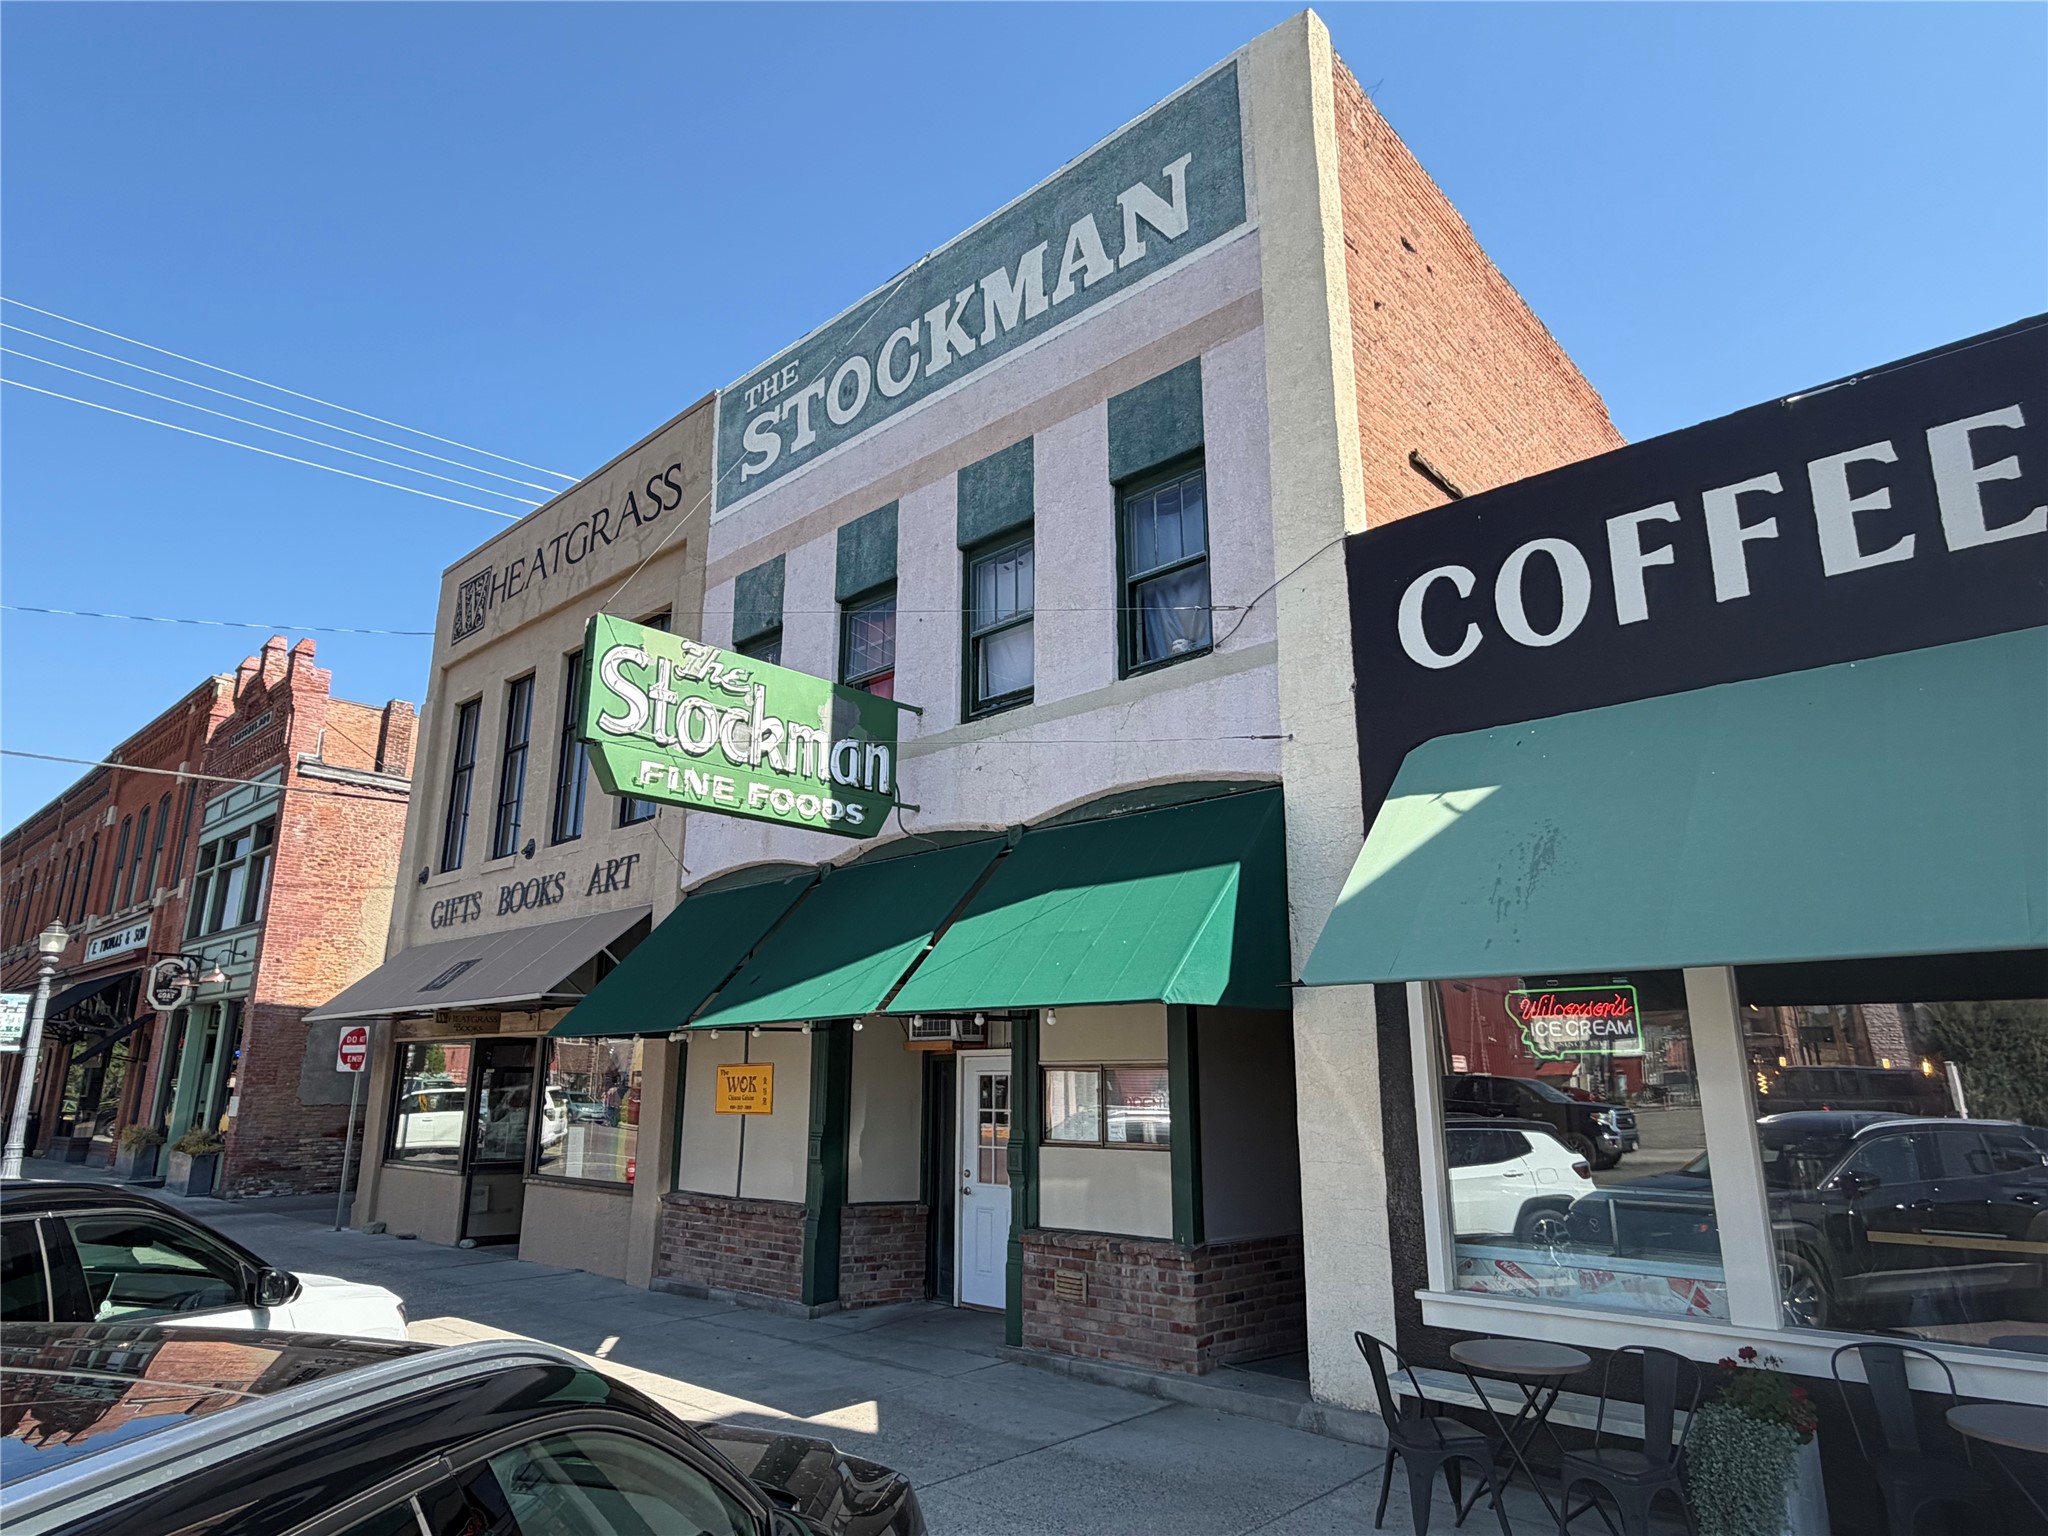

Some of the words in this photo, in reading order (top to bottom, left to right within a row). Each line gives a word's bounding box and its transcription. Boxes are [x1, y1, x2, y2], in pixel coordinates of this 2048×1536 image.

[740, 152, 1192, 483] STOCKMAN
[744, 360, 800, 413] THE
[451, 462, 684, 646] WHEATGRASS
[1398, 404, 2048, 670] COFFEE
[673, 639, 753, 696] The
[596, 643, 893, 797] Stockman
[634, 759, 738, 805] FINE
[747, 781, 867, 826] FOODS
[431, 891, 483, 929] GIFTS
[497, 871, 566, 917] BOOKS
[585, 853, 640, 897] ART
[1520, 993, 1634, 1020] Wilcoxson's
[1530, 1020, 1562, 1037] ICE
[1565, 1019, 1635, 1037] CREAM
[346, 1035, 358, 1044] DO
[726, 1075, 758, 1093] WOK
